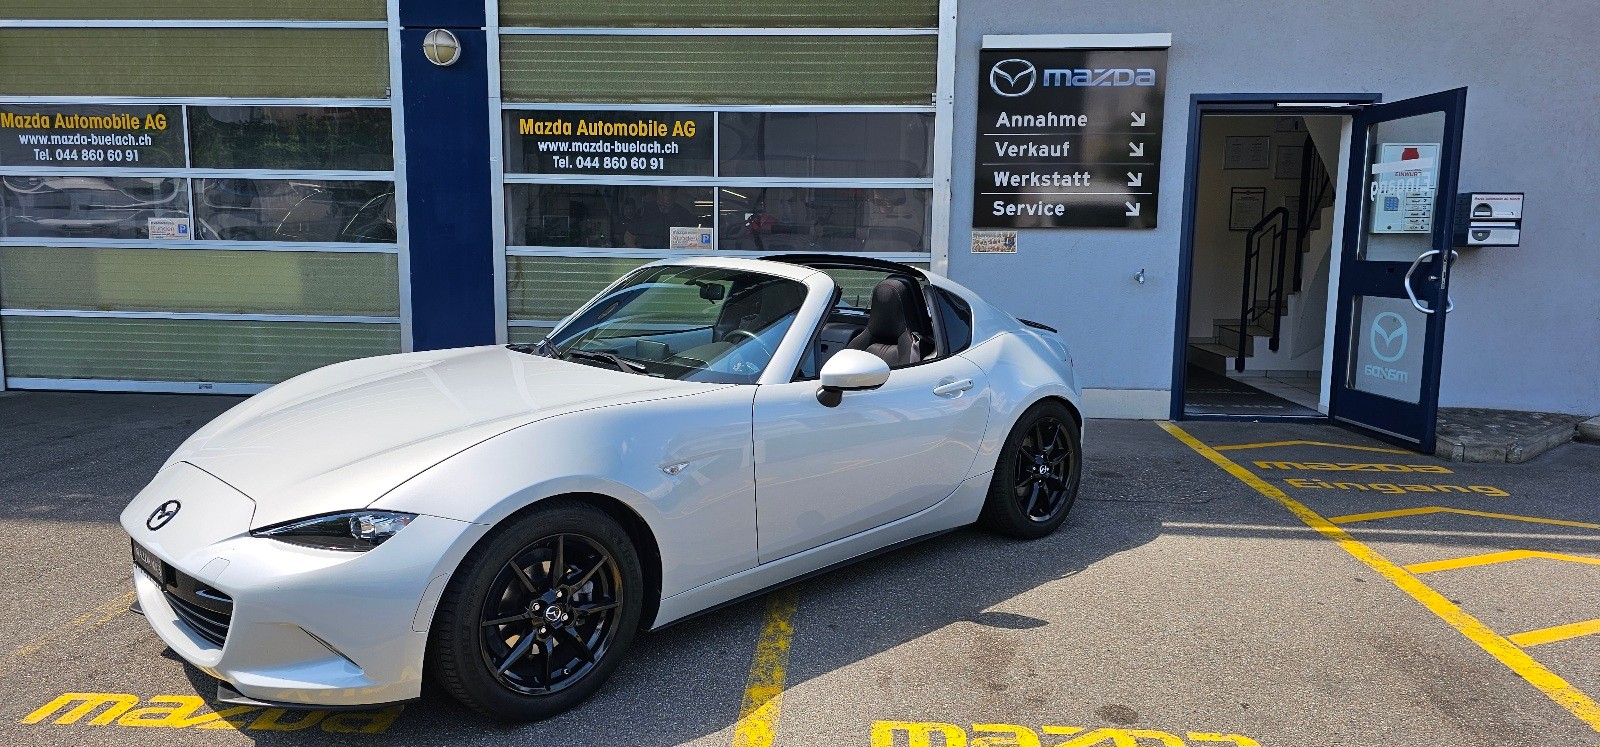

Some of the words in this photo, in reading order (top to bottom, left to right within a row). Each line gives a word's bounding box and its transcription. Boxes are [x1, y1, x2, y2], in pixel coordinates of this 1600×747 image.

[0, 112, 50, 129] Mazda
[54, 113, 140, 130] Automobile
[144, 114, 167, 130] AG
[996, 111, 1088, 127] Annahme
[520, 118, 572, 135] Mazda
[577, 119, 668, 137] Automobile
[672, 120, 696, 137] AG
[19, 133, 152, 146] www.mazda-buelach.ch
[538, 140, 679, 154] www.mazda-buelach.ch
[33, 148, 53, 161] Tel.
[56, 149, 79, 161] 044
[81, 149, 104, 161] 860
[107, 150, 123, 161] 60
[126, 150, 139, 162] 91
[994, 141, 1070, 157] Verkauf
[553, 155, 573, 169] Tel.
[576, 156, 600, 169] 044
[603, 157, 628, 169] 860
[631, 157, 647, 169] 60
[650, 157, 664, 170] 91
[993, 171, 1091, 187] Werkstatt
[992, 201, 1065, 217] Service
[1283, 477, 1511, 498] Eingang
